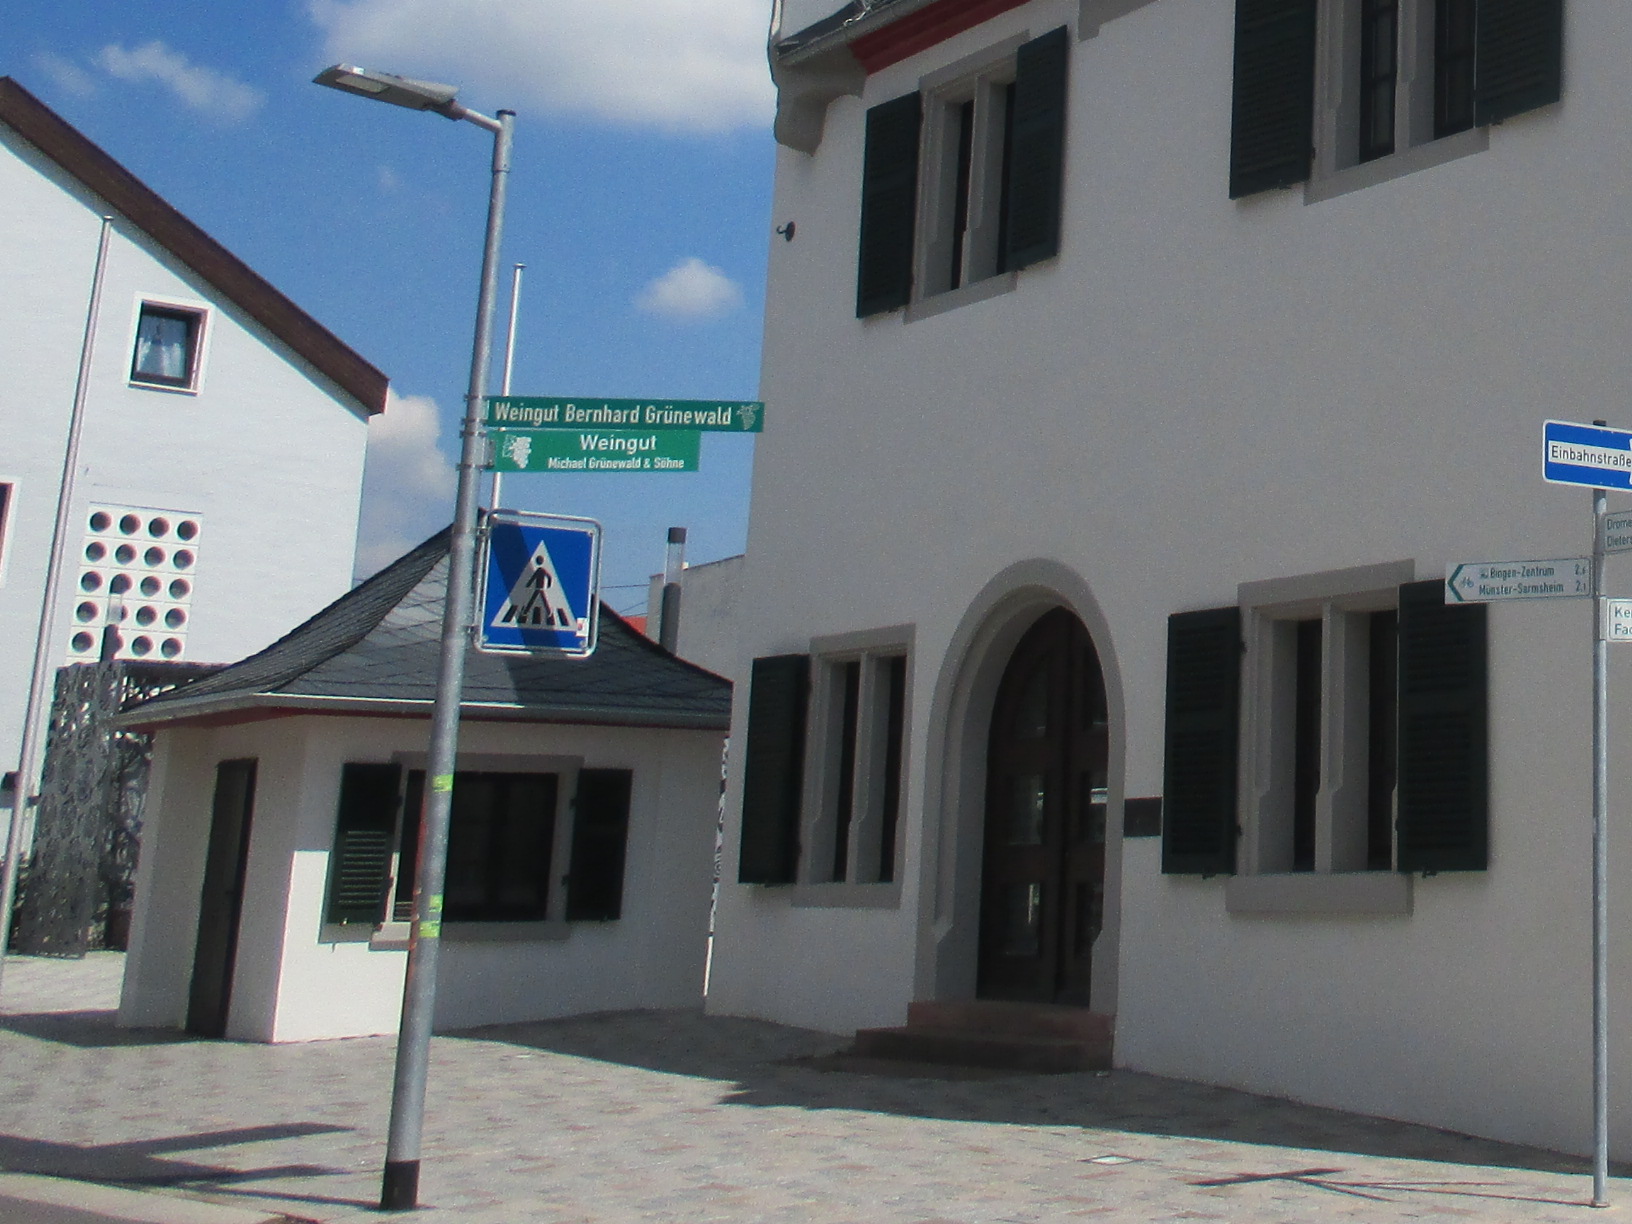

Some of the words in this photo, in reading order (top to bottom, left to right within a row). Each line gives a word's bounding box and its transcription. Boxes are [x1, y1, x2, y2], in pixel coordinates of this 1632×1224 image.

[495, 401, 560, 425] Weingut
[565, 405, 640, 424] Bernhard
[645, 404, 732, 426] Grünewald
[580, 434, 658, 454] Weingut
[548, 457, 587, 469] Michael
[589, 457, 641, 470] Grünewald
[643, 458, 650, 469] &
[654, 457, 685, 469] Söhne
[1551, 444, 1632, 468] Einbahnstraße
[1490, 565, 1555, 581] Bingen-Zentrum
[1479, 581, 1564, 596] Münster-Sarmsheim
